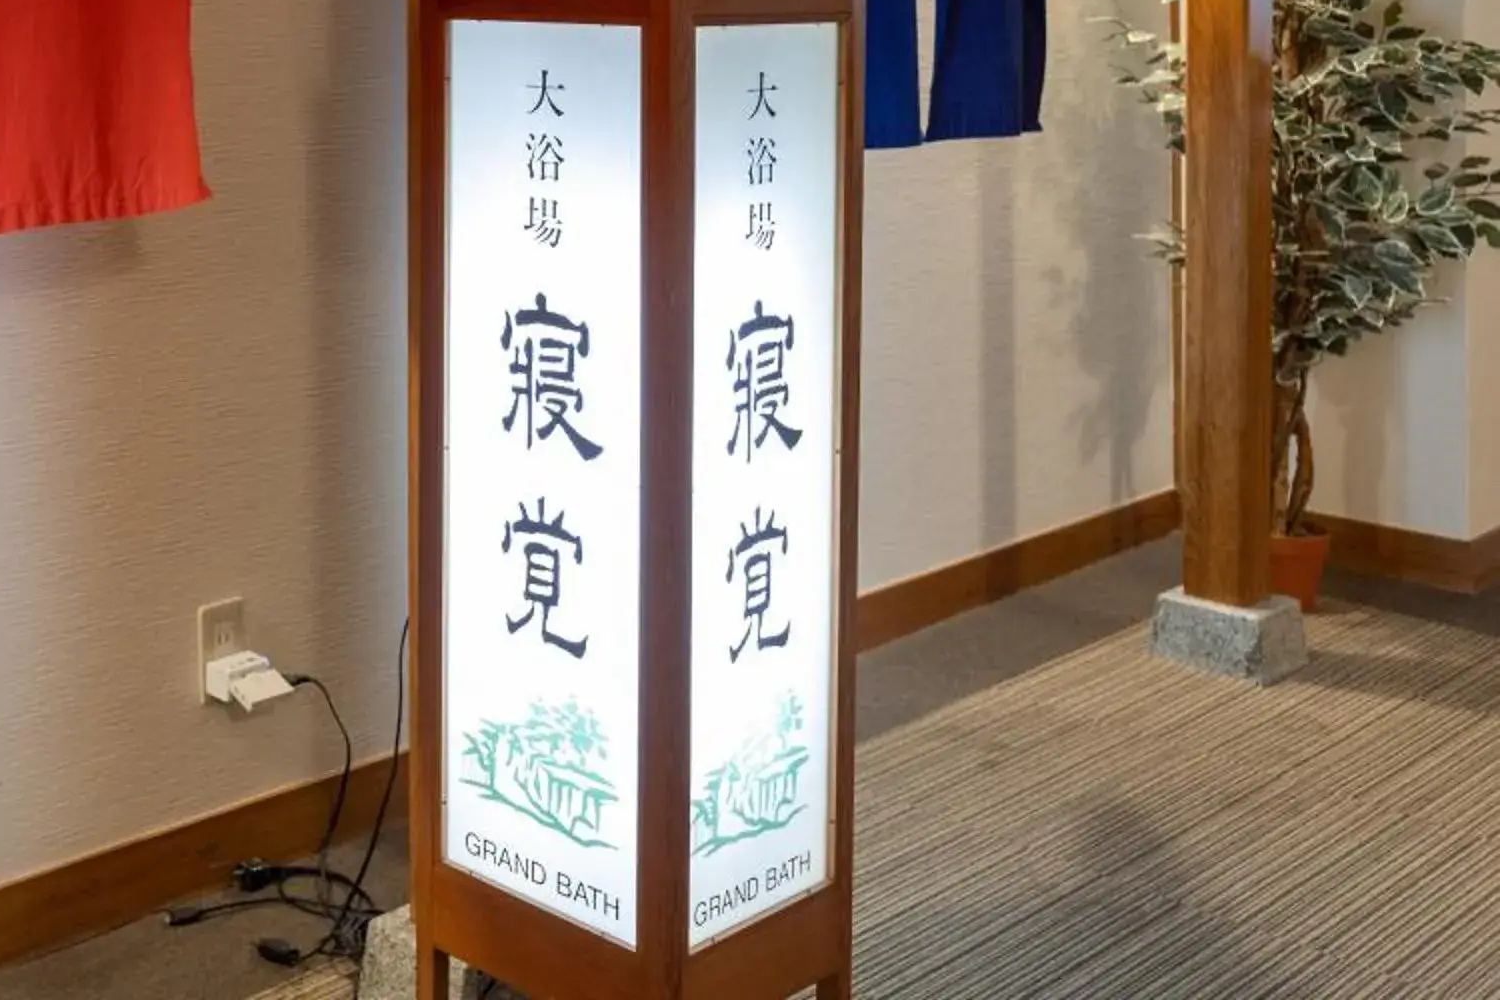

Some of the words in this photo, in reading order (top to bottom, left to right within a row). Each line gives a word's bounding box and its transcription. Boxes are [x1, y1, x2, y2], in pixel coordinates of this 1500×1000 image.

[524, 69, 567, 249] 大浴場
[745, 71, 780, 251] 大浴場
[464, 831, 548, 886] GRAND
[555, 876, 621, 921] BATH
[693, 880, 759, 928] GRAND
[765, 850, 812, 894] BATH
